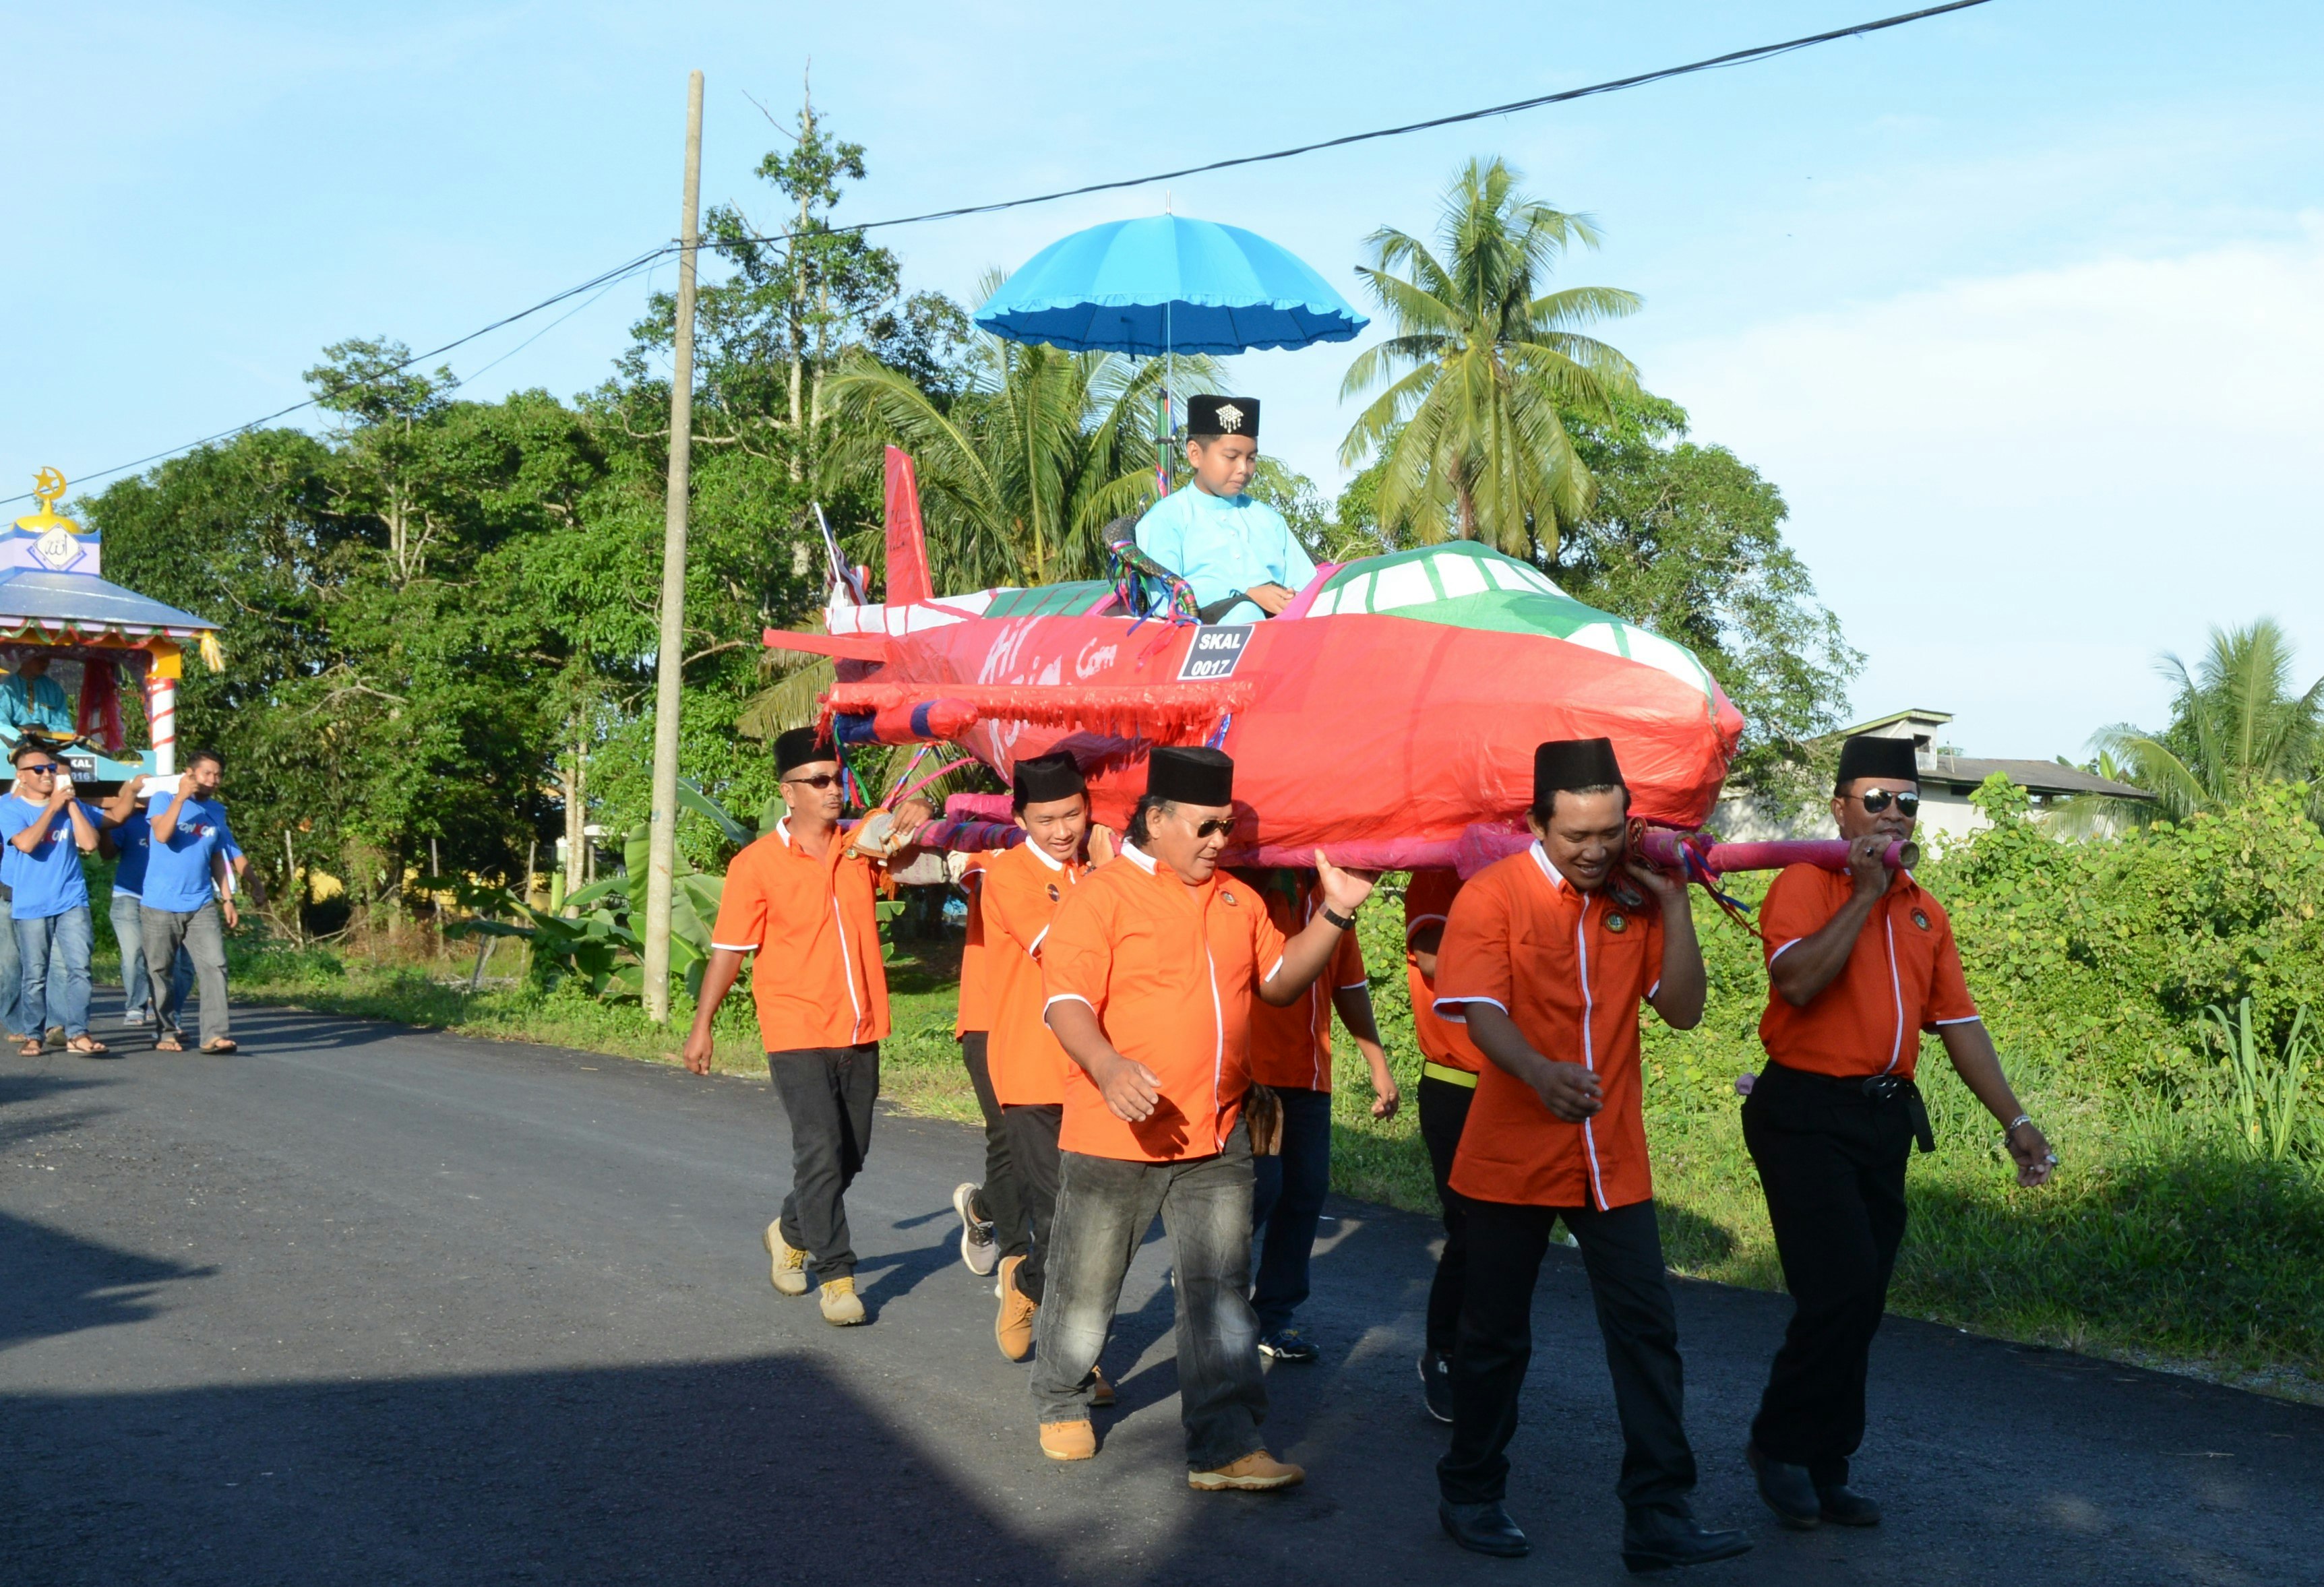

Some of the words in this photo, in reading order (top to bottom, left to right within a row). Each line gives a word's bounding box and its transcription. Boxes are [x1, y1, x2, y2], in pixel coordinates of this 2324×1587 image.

[1199, 633, 1240, 650] SKAL
[1191, 660, 1230, 676] 0017
[70, 759, 92, 768] KAL
[71, 772, 90, 780] 016
